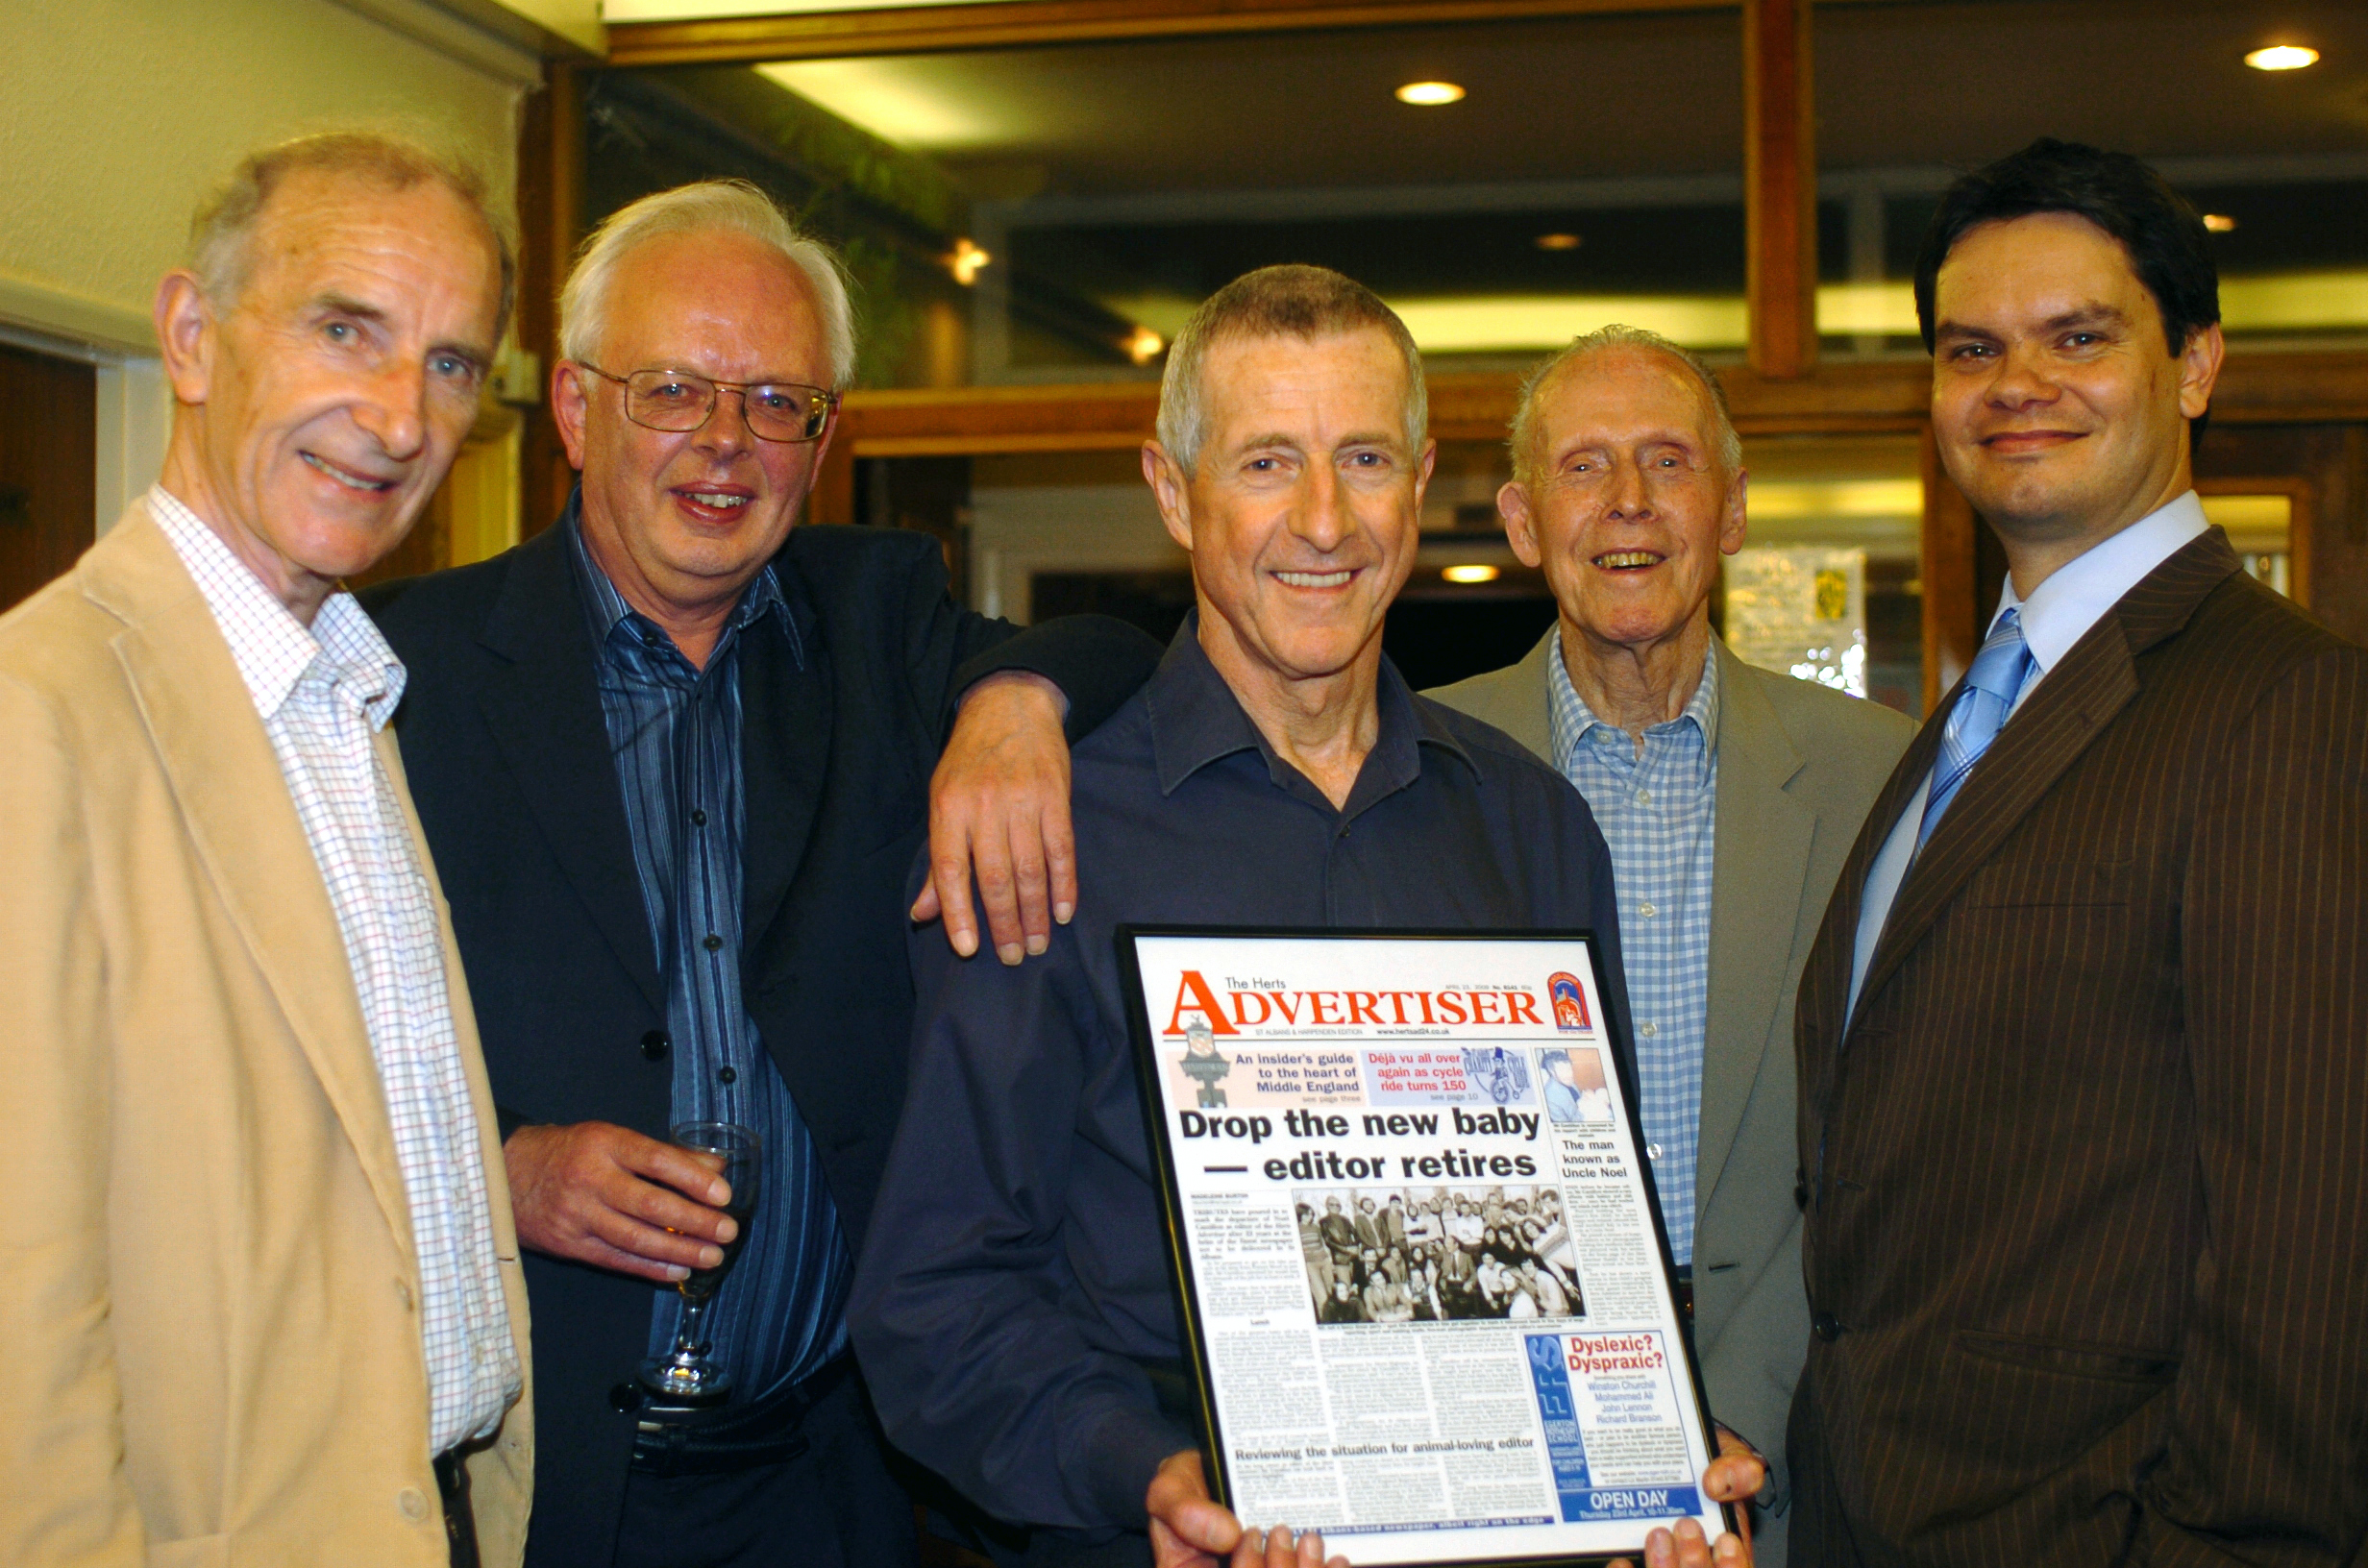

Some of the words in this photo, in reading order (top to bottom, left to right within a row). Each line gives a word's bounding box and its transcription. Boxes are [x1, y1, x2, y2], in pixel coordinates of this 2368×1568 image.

[1225, 976, 1248, 989] The
[1252, 976, 1286, 989] Herts
[1163, 969, 1544, 1035] ADVERTISER
[1236, 1053, 1253, 1065] An
[1257, 1053, 1313, 1065] insider's
[1319, 1053, 1354, 1066] guide
[1369, 1052, 1395, 1066] Déjà
[1399, 1054, 1414, 1064] vu
[1418, 1053, 1432, 1064] all
[1436, 1054, 1461, 1064] over
[1258, 1068, 1271, 1078] to
[1277, 1067, 1298, 1078] the
[1304, 1067, 1339, 1078] heart
[1344, 1066, 1357, 1078] of
[1377, 1067, 1411, 1080] again
[1415, 1068, 1428, 1078] as
[1432, 1066, 1464, 1079] cycle
[1256, 1081, 1301, 1092] Middle
[1307, 1081, 1360, 1094] England
[1381, 1081, 1403, 1091] ride
[1407, 1081, 1438, 1091] turns
[1443, 1080, 1467, 1091] 150
[1446, 1093, 1466, 1103] page
[1468, 1092, 1479, 1101] 10
[1179, 1110, 1272, 1145] Drop
[1283, 1108, 1349, 1137] the
[1363, 1113, 1439, 1138] new
[1453, 1107, 1542, 1141] baby
[1562, 1139, 1585, 1150] The
[1589, 1141, 1615, 1150] man
[1264, 1151, 1386, 1181] editor
[1401, 1148, 1538, 1179] retires
[1562, 1154, 1602, 1164] known
[1607, 1155, 1621, 1164] as
[1562, 1167, 1596, 1178] Uncle
[1600, 1166, 1628, 1178] Noel
[1570, 1334, 1652, 1356] Dyslexic?
[1567, 1351, 1664, 1374] Dyspraxic?
[1621, 1380, 1656, 1389] Churchill
[1643, 1390, 1654, 1400] Ali
[1602, 1404, 1621, 1412] John
[1622, 1403, 1652, 1411] Lennon
[1596, 1414, 1627, 1424] Richard
[1629, 1412, 1663, 1423] Branson
[1235, 1447, 1301, 1461] Reviewing
[1306, 1446, 1327, 1458] the
[1332, 1443, 1388, 1456] situation
[1391, 1442, 1409, 1454] for
[1413, 1438, 1494, 1455] animal-loving
[1498, 1436, 1534, 1449] editor
[1591, 1491, 1635, 1509] OPEN
[1637, 1489, 1668, 1507] DAY
